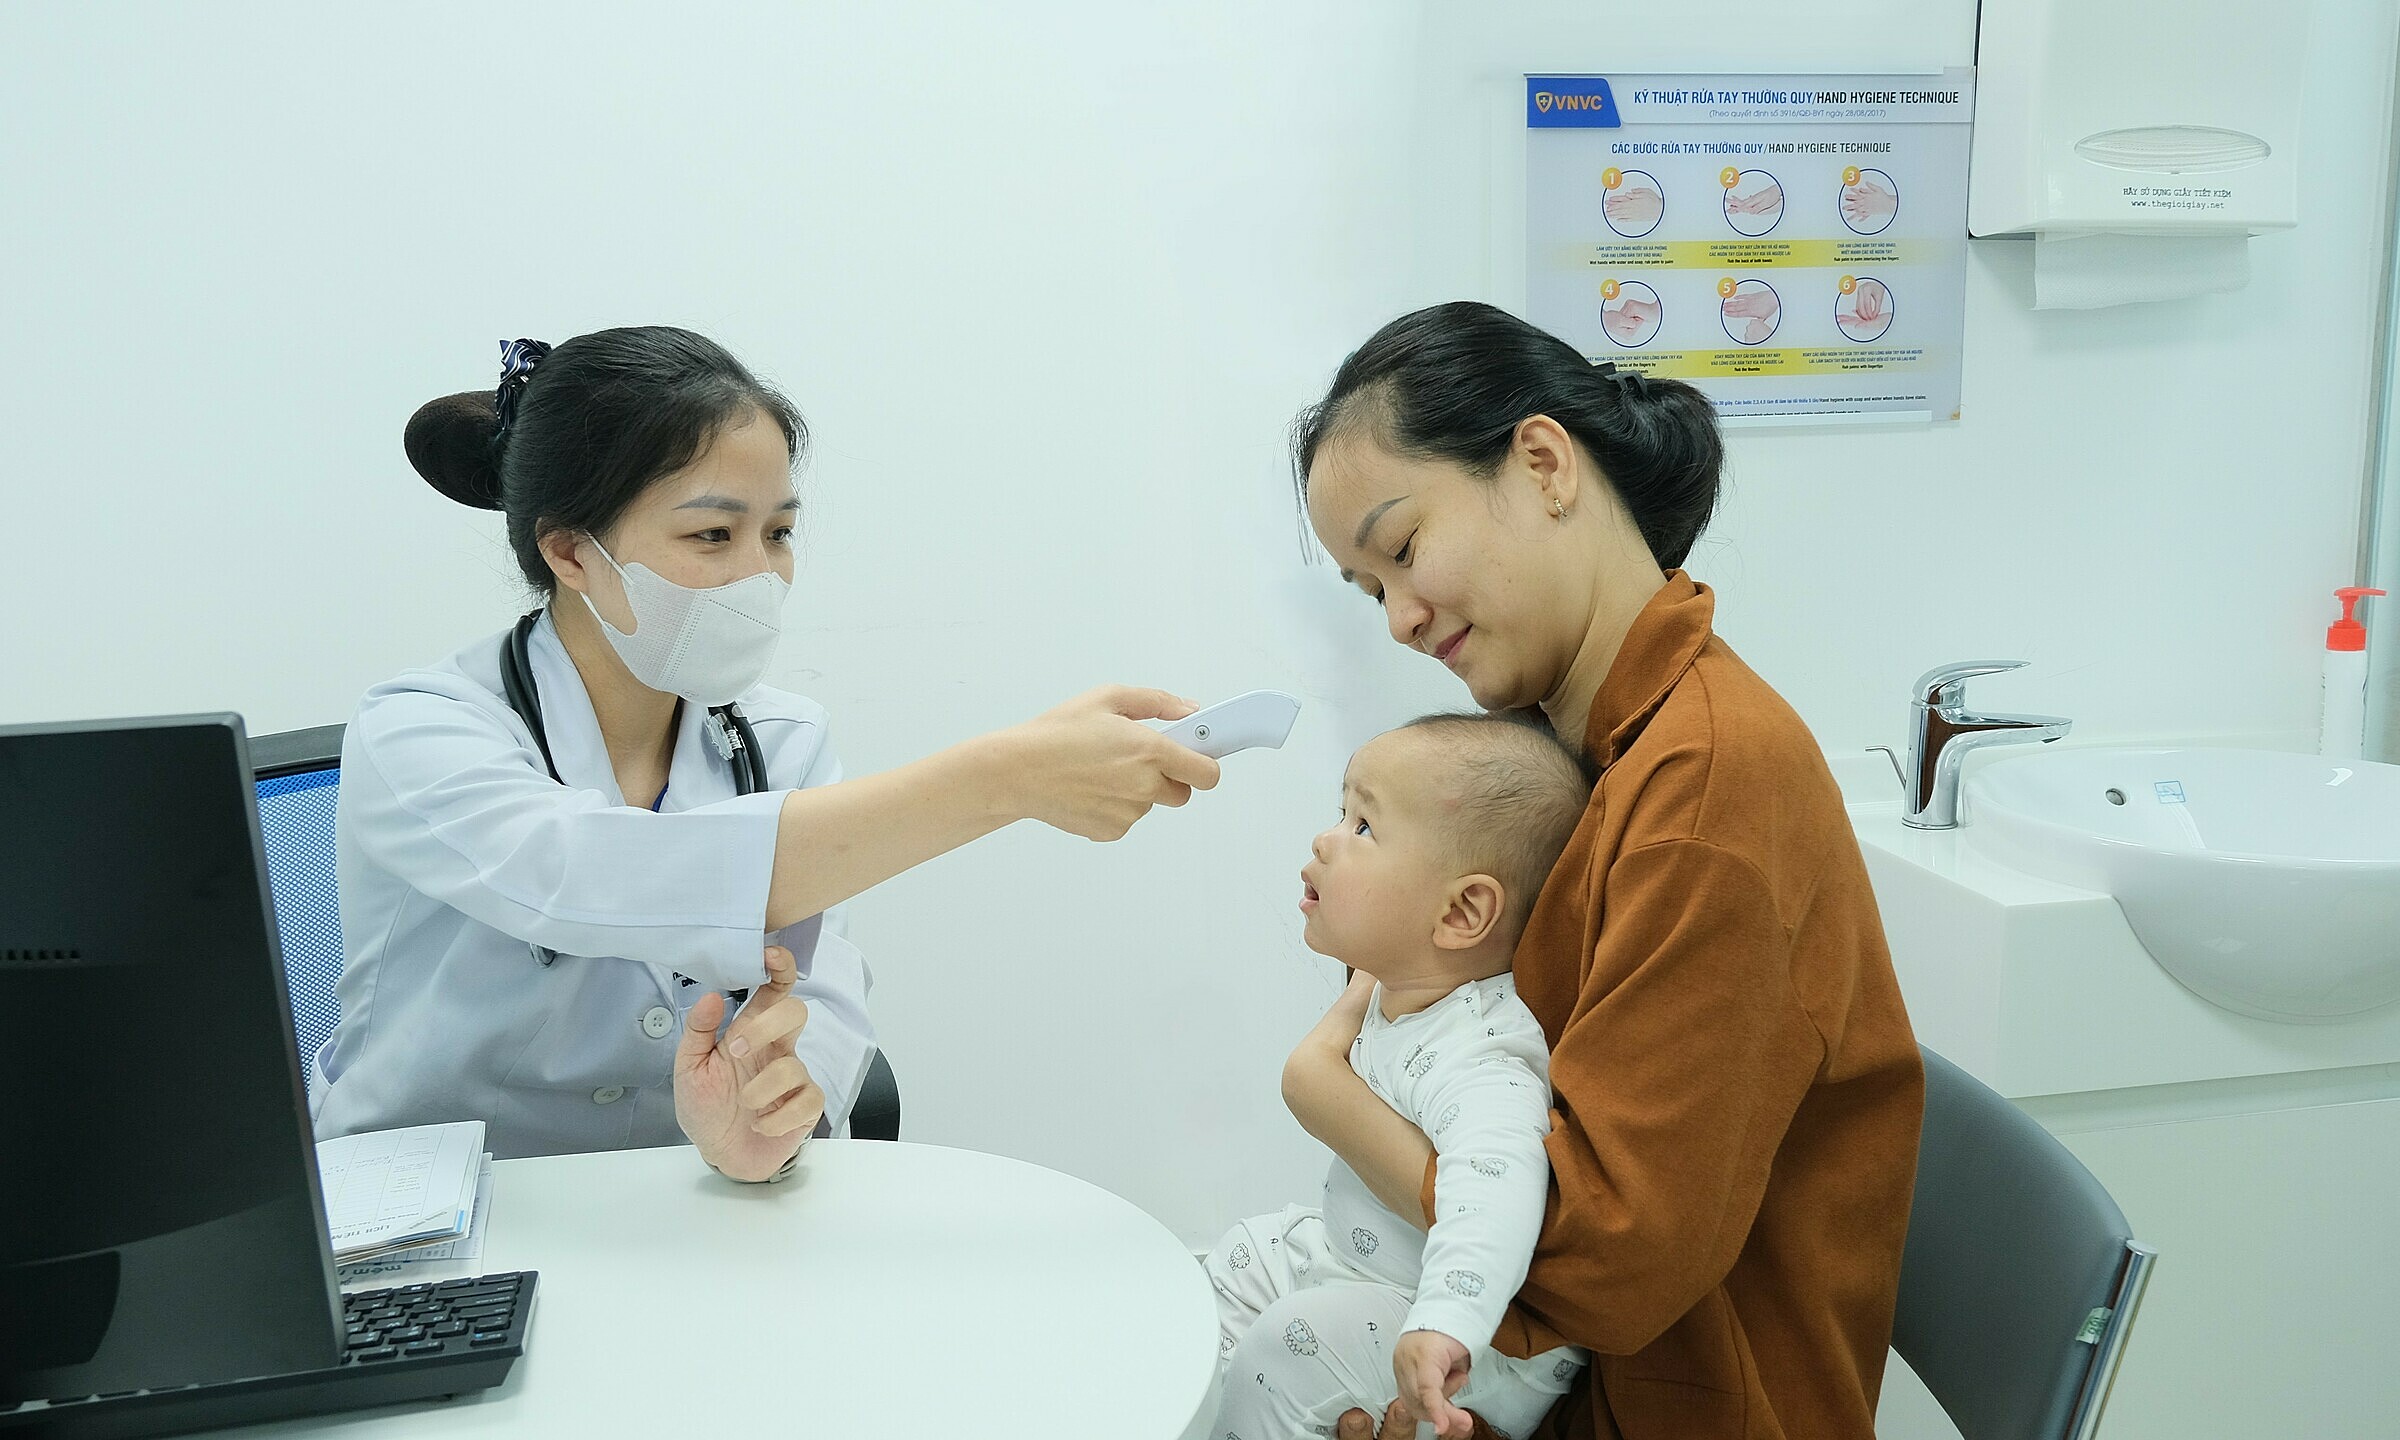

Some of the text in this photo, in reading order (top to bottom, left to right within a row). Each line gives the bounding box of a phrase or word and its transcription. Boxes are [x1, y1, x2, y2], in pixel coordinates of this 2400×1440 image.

[1555, 95, 1602, 111] VNVC
[1651, 91, 1688, 107] THUẬT
[1691, 88, 1714, 104] RỬA
[1718, 91, 1739, 104] TAY
[1850, 91, 1896, 104] HYGIENE
[1900, 91, 1959, 104] TECHNIQUE
[1611, 141, 1630, 154] CÁC
[1633, 141, 1658, 154] BƯỚC
[1661, 140, 1680, 154] RỬA
[1683, 143, 1700, 153] TAY
[1797, 143, 1837, 153] HYGIENE
[1839, 143, 1891, 153] TECHNIQUE
[1608, 172, 1616, 184] 1
[1725, 172, 1734, 184] 2
[1847, 170, 1856, 182] 3
[2131, 200, 2224, 210] www.thegioigiay.net
[1605, 282, 1615, 295] 4
[1723, 282, 1731, 294] 5
[1842, 279, 1851, 291] 6
